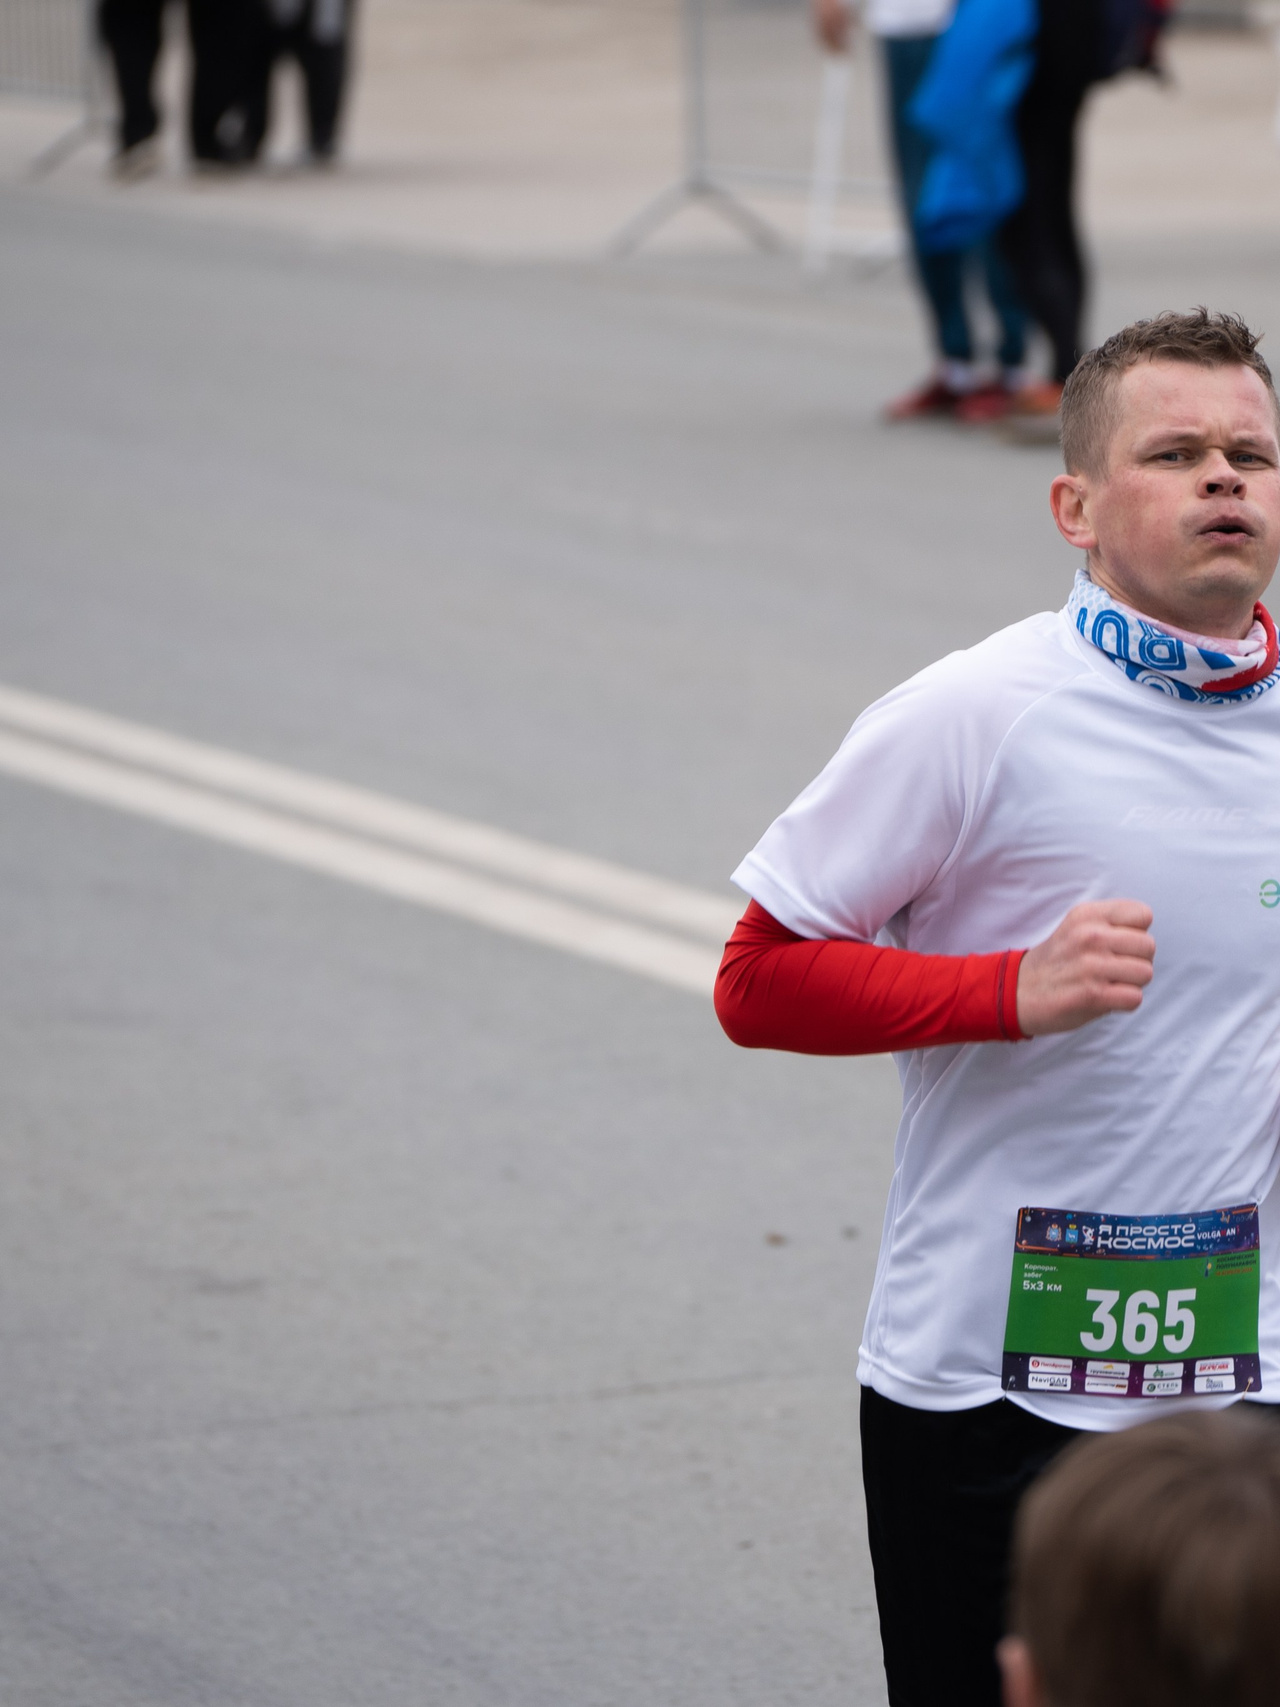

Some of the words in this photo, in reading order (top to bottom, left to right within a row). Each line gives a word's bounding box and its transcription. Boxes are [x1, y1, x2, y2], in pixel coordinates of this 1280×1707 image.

[1099, 1224, 1113, 1236] Я
[1116, 1223, 1196, 1237] ПРОСТО
[1097, 1235, 1196, 1249] КОСМОС
[1079, 1288, 1197, 1355] 365
